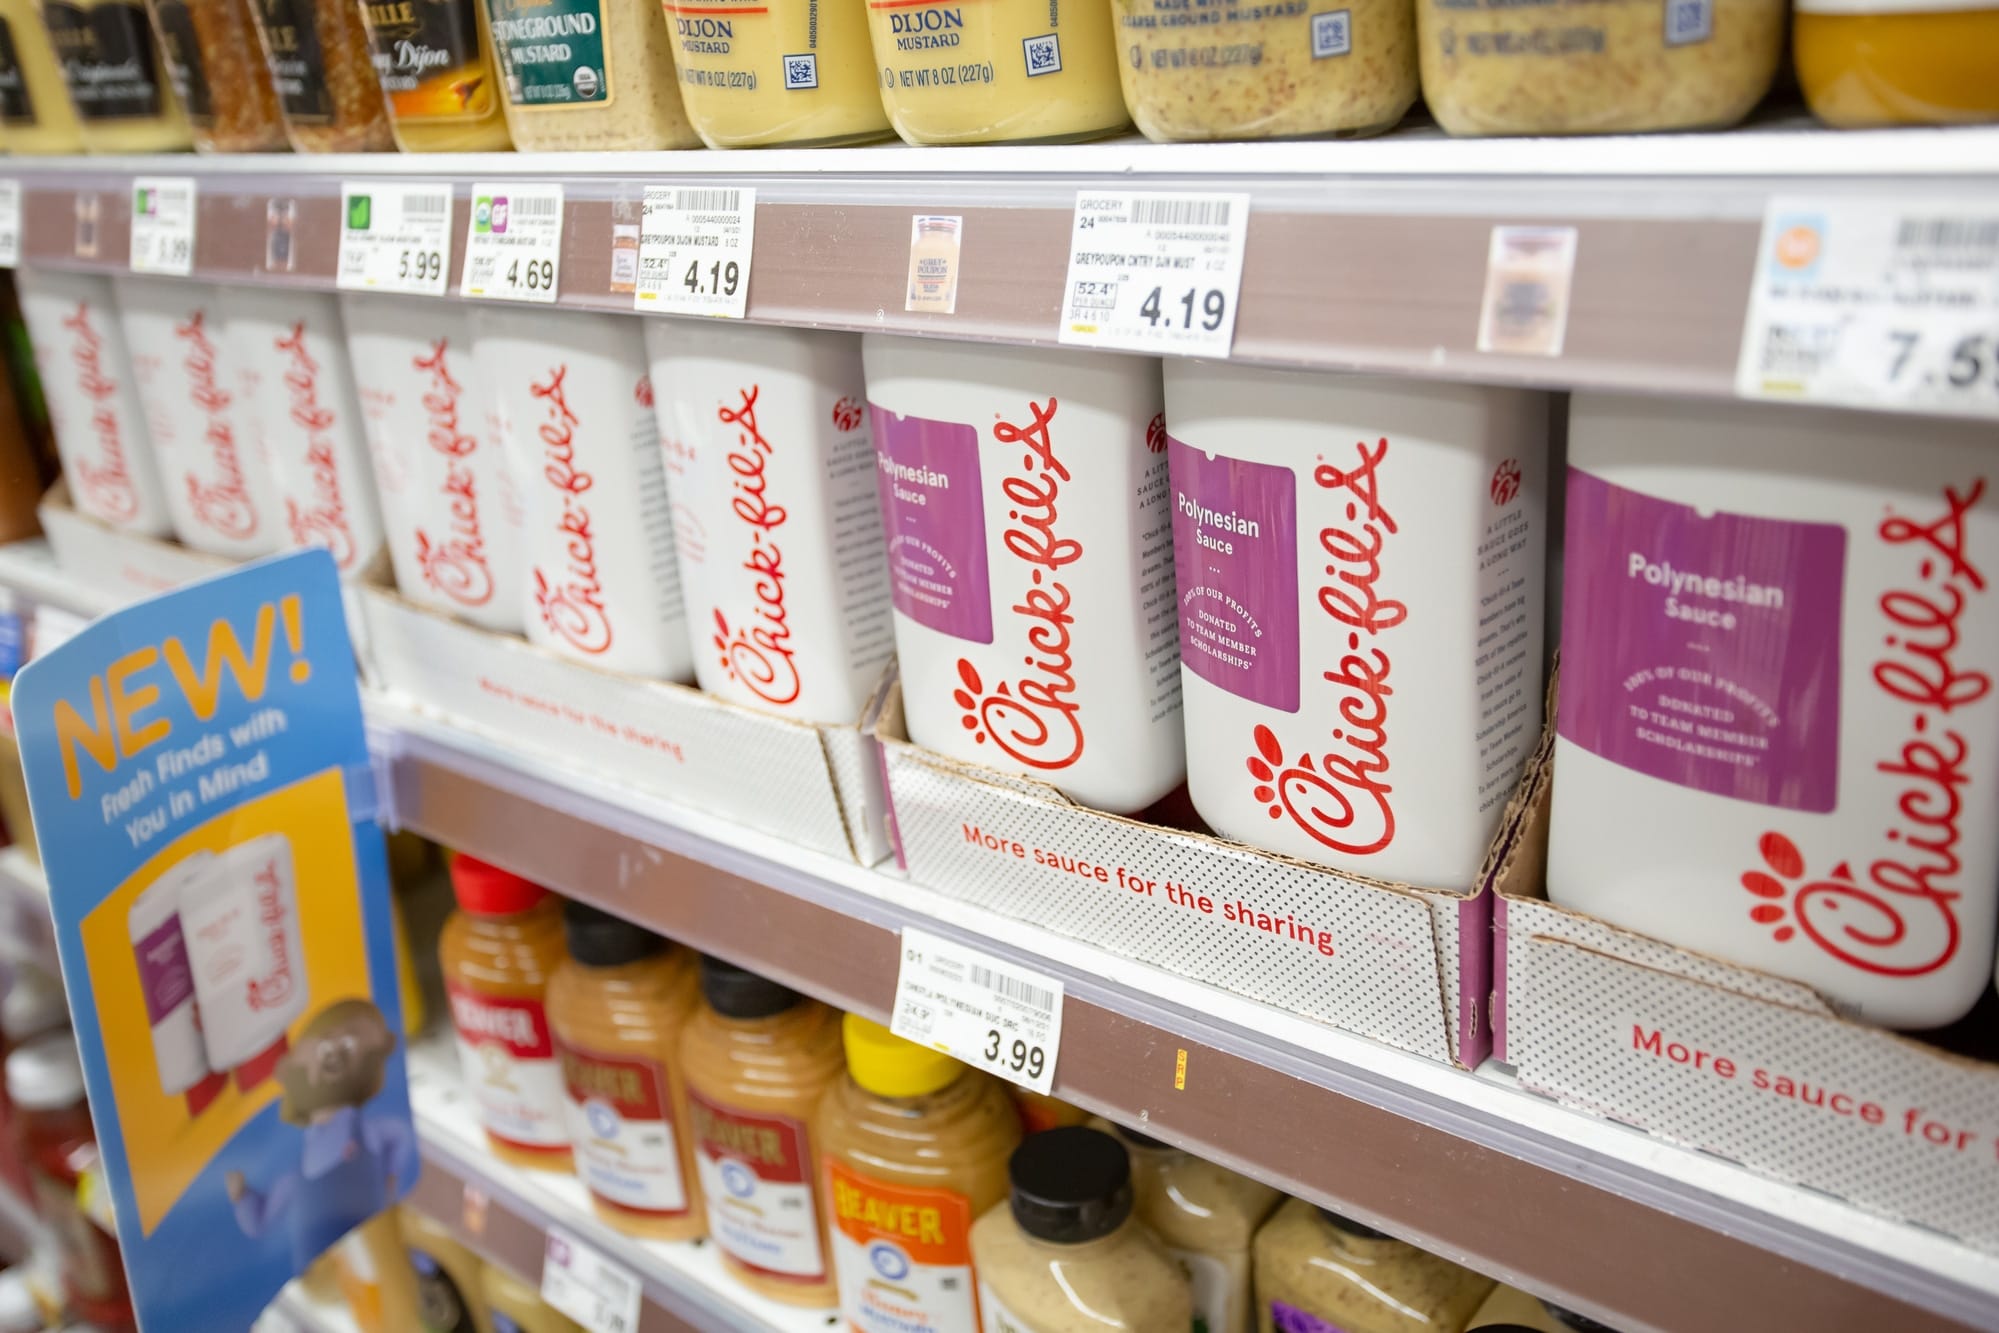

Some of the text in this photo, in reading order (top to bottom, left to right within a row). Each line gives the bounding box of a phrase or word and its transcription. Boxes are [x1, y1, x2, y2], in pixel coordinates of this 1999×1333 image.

[676, 18, 734, 38] DIJON
[889, 8, 964, 34] DIJON
[1161, 12, 1221, 28] GROUND
[1226, 1, 1308, 21] MUSTARD
[394, 40, 450, 74] Dijon
[682, 41, 730, 54] MUSTARD
[897, 32, 960, 51] MUSTARD
[707, 71, 713, 86] 8
[714, 72, 726, 87] OZ
[727, 69, 757, 90] (227g)
[899, 61, 994, 88] NET WT 8 OZ (227g)
[642, 205, 653, 216] 24
[1080, 200, 1123, 211] GROCERY
[1080, 216, 1095, 229] 24
[400, 251, 441, 281] 5.99
[507, 259, 554, 290] 4.69
[684, 259, 740, 296] 4.19
[1075, 252, 1125, 266] GREYPOUPON
[1173, 257, 1196, 269] MUST
[1140, 286, 1226, 331] 4.19
[1887, 328, 1999, 390] 7.5
[412, 336, 495, 607] Chick-fil-A
[877, 450, 949, 489] Polynesian
[1144, 470, 1150, 479] A
[892, 483, 927, 506] Sauce
[1137, 478, 1164, 496] SAUCE
[530, 363, 613, 656] Chick-fil-A
[1139, 500, 1145, 509] A
[1178, 491, 1260, 538] Polynesian
[1486, 509, 1522, 535] A LITTLE
[715, 383, 801, 706] Chick-fil-A
[1196, 528, 1233, 555] Sauce
[1478, 533, 1505, 556] SAUCE
[1480, 537, 1527, 571] A LONG WAY
[922, 542, 957, 579] PROFITS
[918, 576, 953, 596] MEMBER
[980, 397, 1084, 771] Chick-fil-A
[1628, 552, 1784, 608] Polynesian
[1196, 585, 1205, 596] OF
[1206, 587, 1223, 602] OUR
[1225, 595, 1263, 638] PROFITS
[1198, 609, 1237, 633] DONATED
[1664, 597, 1736, 630] Sauce
[1186, 617, 1257, 657] TO TEAM MEMBER
[1277, 437, 1408, 856] Chick-fil-A
[1677, 667, 1712, 686] OUR
[52, 592, 311, 800] NEW!
[1658, 694, 1735, 723] DONATED
[1629, 704, 1769, 749] TO TEAM MEMBER
[1793, 477, 1992, 978] Chick-fil-A
[100, 708, 288, 824] Fresh Finds with
[125, 751, 271, 849] You in Mind
[962, 822, 1336, 958] More sauce for the sharing
[985, 1029, 1046, 1079] 3.99
[1176, 1050, 1185, 1085] SRP
[1632, 1023, 1978, 1155] More sauce for
[834, 1178, 945, 1246] BEAVER
